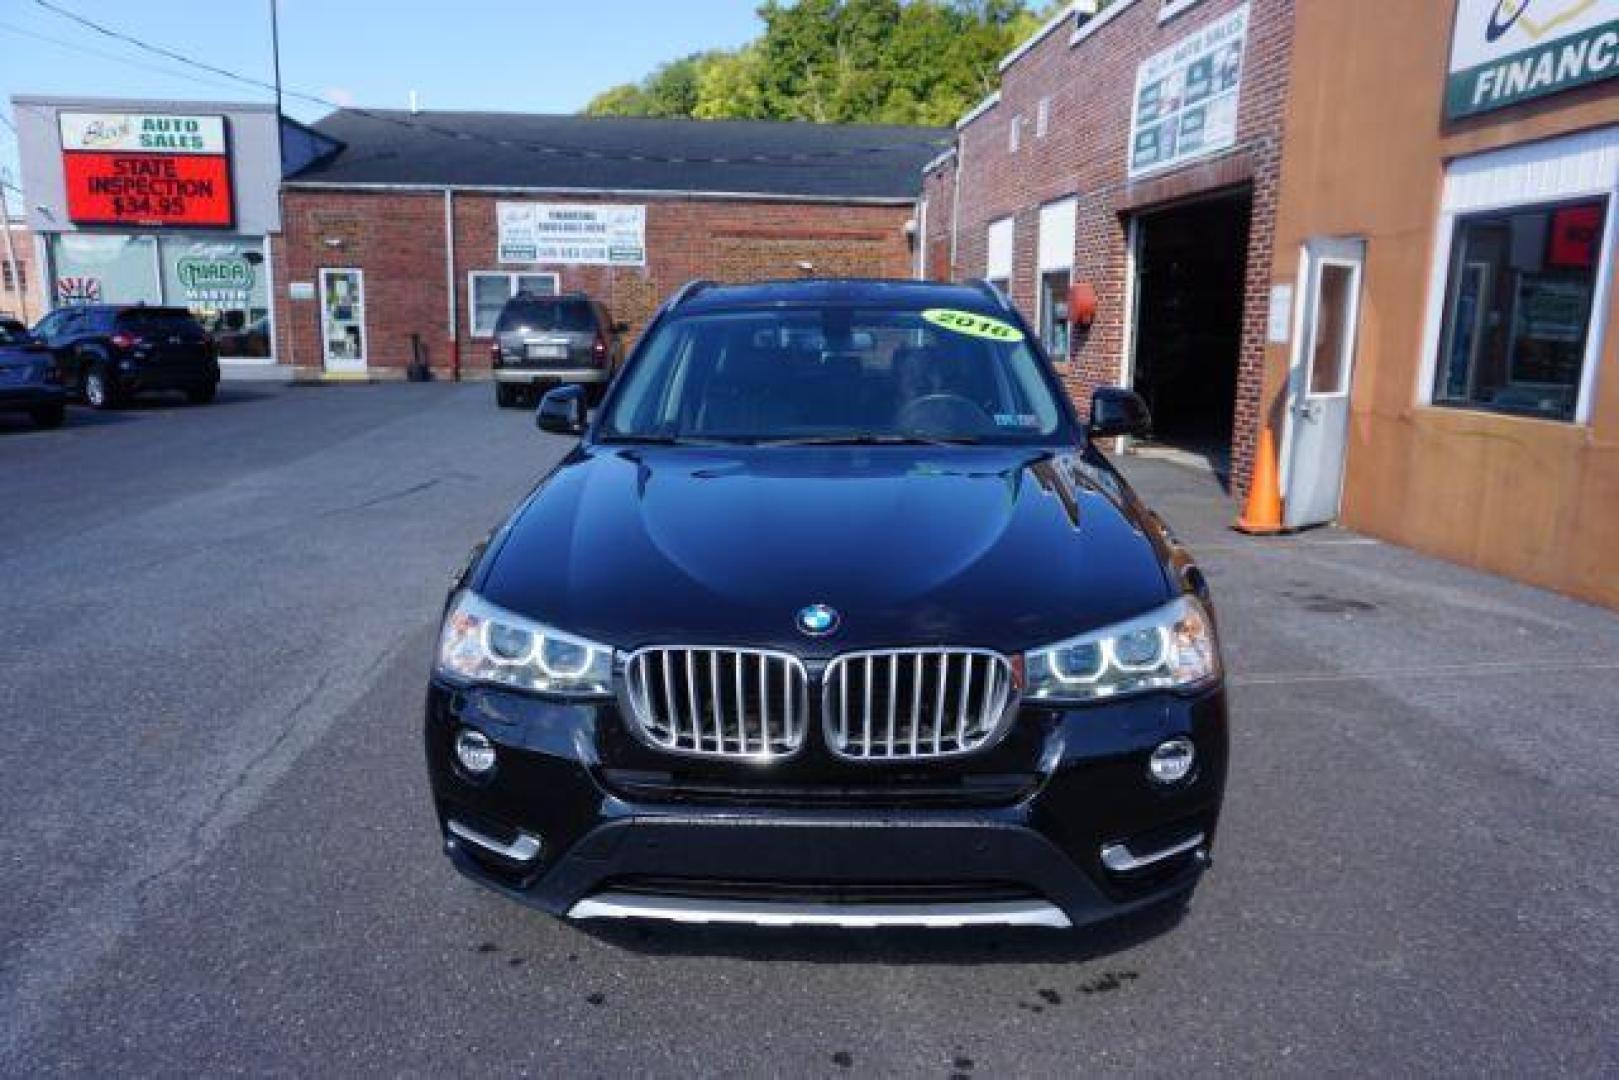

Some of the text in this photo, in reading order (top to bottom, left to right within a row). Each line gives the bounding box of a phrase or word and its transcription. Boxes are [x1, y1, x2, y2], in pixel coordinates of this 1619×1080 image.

[1472, 31, 1619, 105] FINANC
[143, 118, 199, 132] AUTO
[139, 133, 203, 149] SALES
[113, 158, 177, 178] STATE
[88, 176, 214, 198] INSPECTION
[113, 197, 187, 216] $34.95
[935, 313, 1011, 337] 2016
